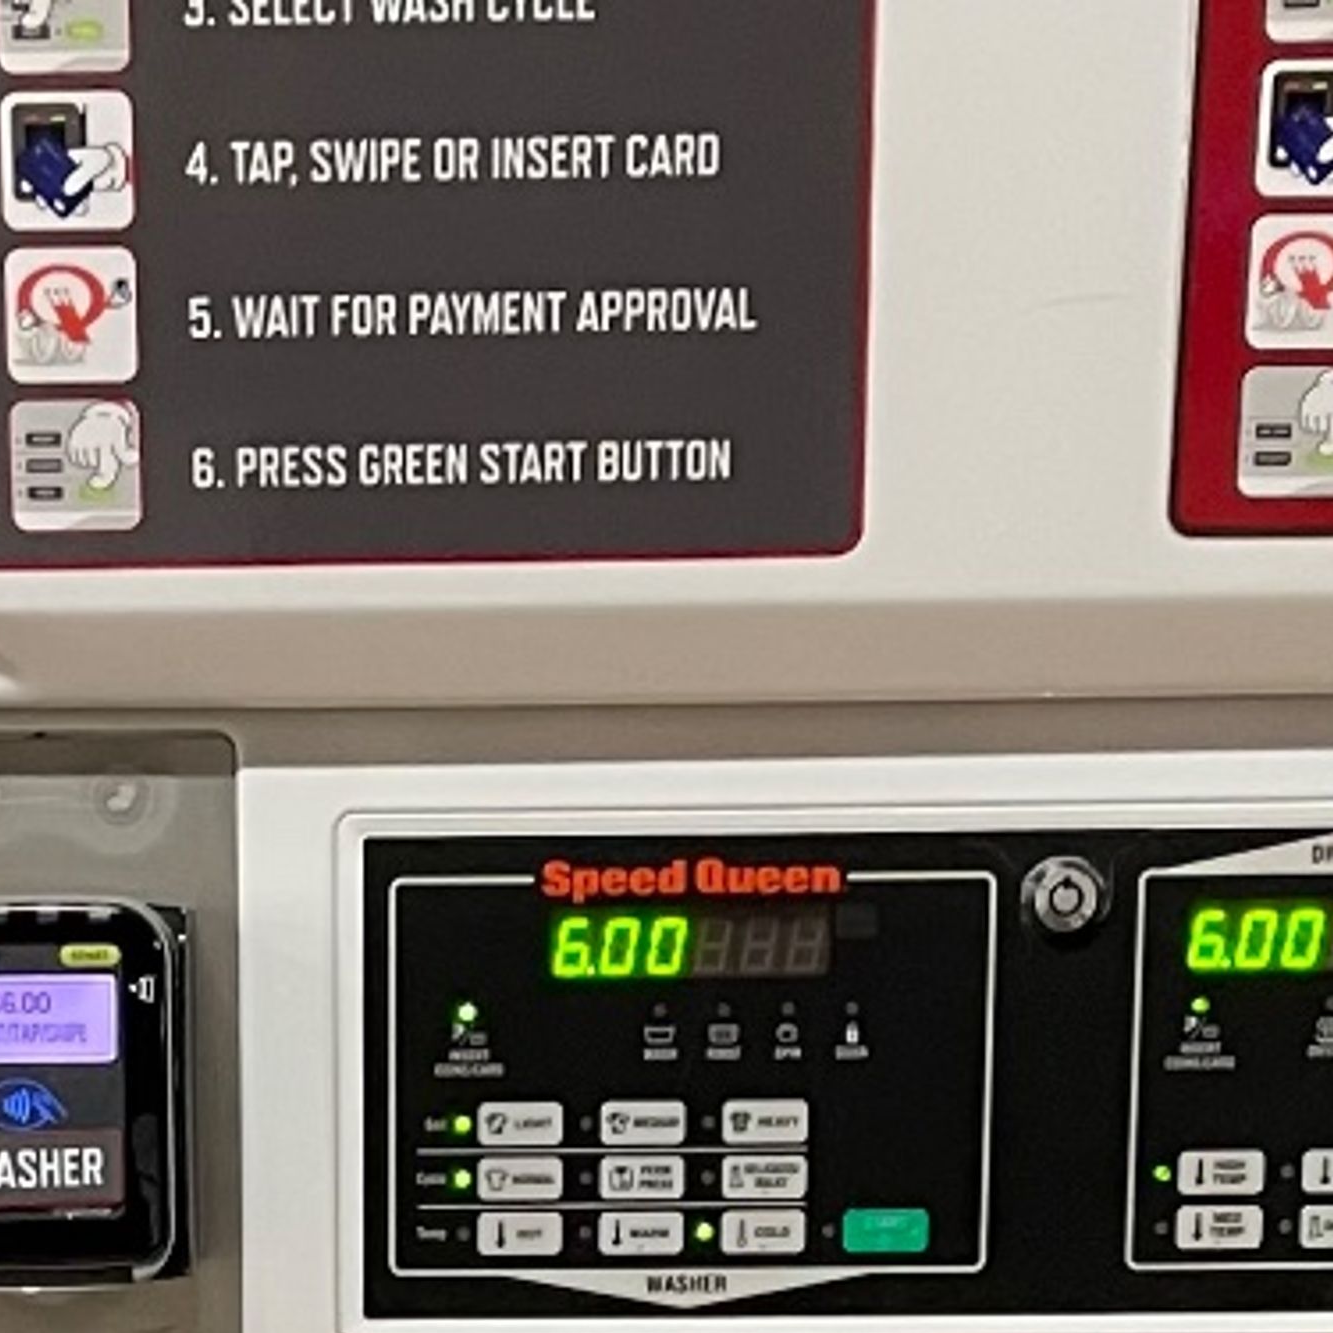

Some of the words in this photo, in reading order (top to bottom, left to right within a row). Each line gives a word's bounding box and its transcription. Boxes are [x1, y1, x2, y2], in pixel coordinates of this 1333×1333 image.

[184, 0, 215, 26] 3.
[229, 0, 353, 25] SELECT
[372, 0, 474, 23] WASH
[186, 142, 218, 184] 4.
[231, 141, 297, 186] TAP,
[310, 138, 421, 182] SWIPE
[434, 138, 478, 180] OR
[492, 135, 615, 179] INSERT
[626, 134, 720, 177] CARD
[189, 297, 221, 338] 5.
[231, 295, 320, 338] WAIT
[332, 295, 396, 335] FOR
[409, 292, 567, 334] PAYMENT
[576, 288, 757, 331] APPROVAL
[192, 448, 224, 488] 6.
[237, 446, 347, 487] PRESS
[359, 444, 467, 485] GREEN
[479, 442, 588, 483] START
[597, 440, 731, 481] BUTTON
[542, 859, 687, 901] Speed
[696, 857, 842, 894] Queen
[552, 916, 689, 979] 6.00
[1187, 908, 1325, 969] 6.00
[646, 1275, 728, 1294] WASHER
